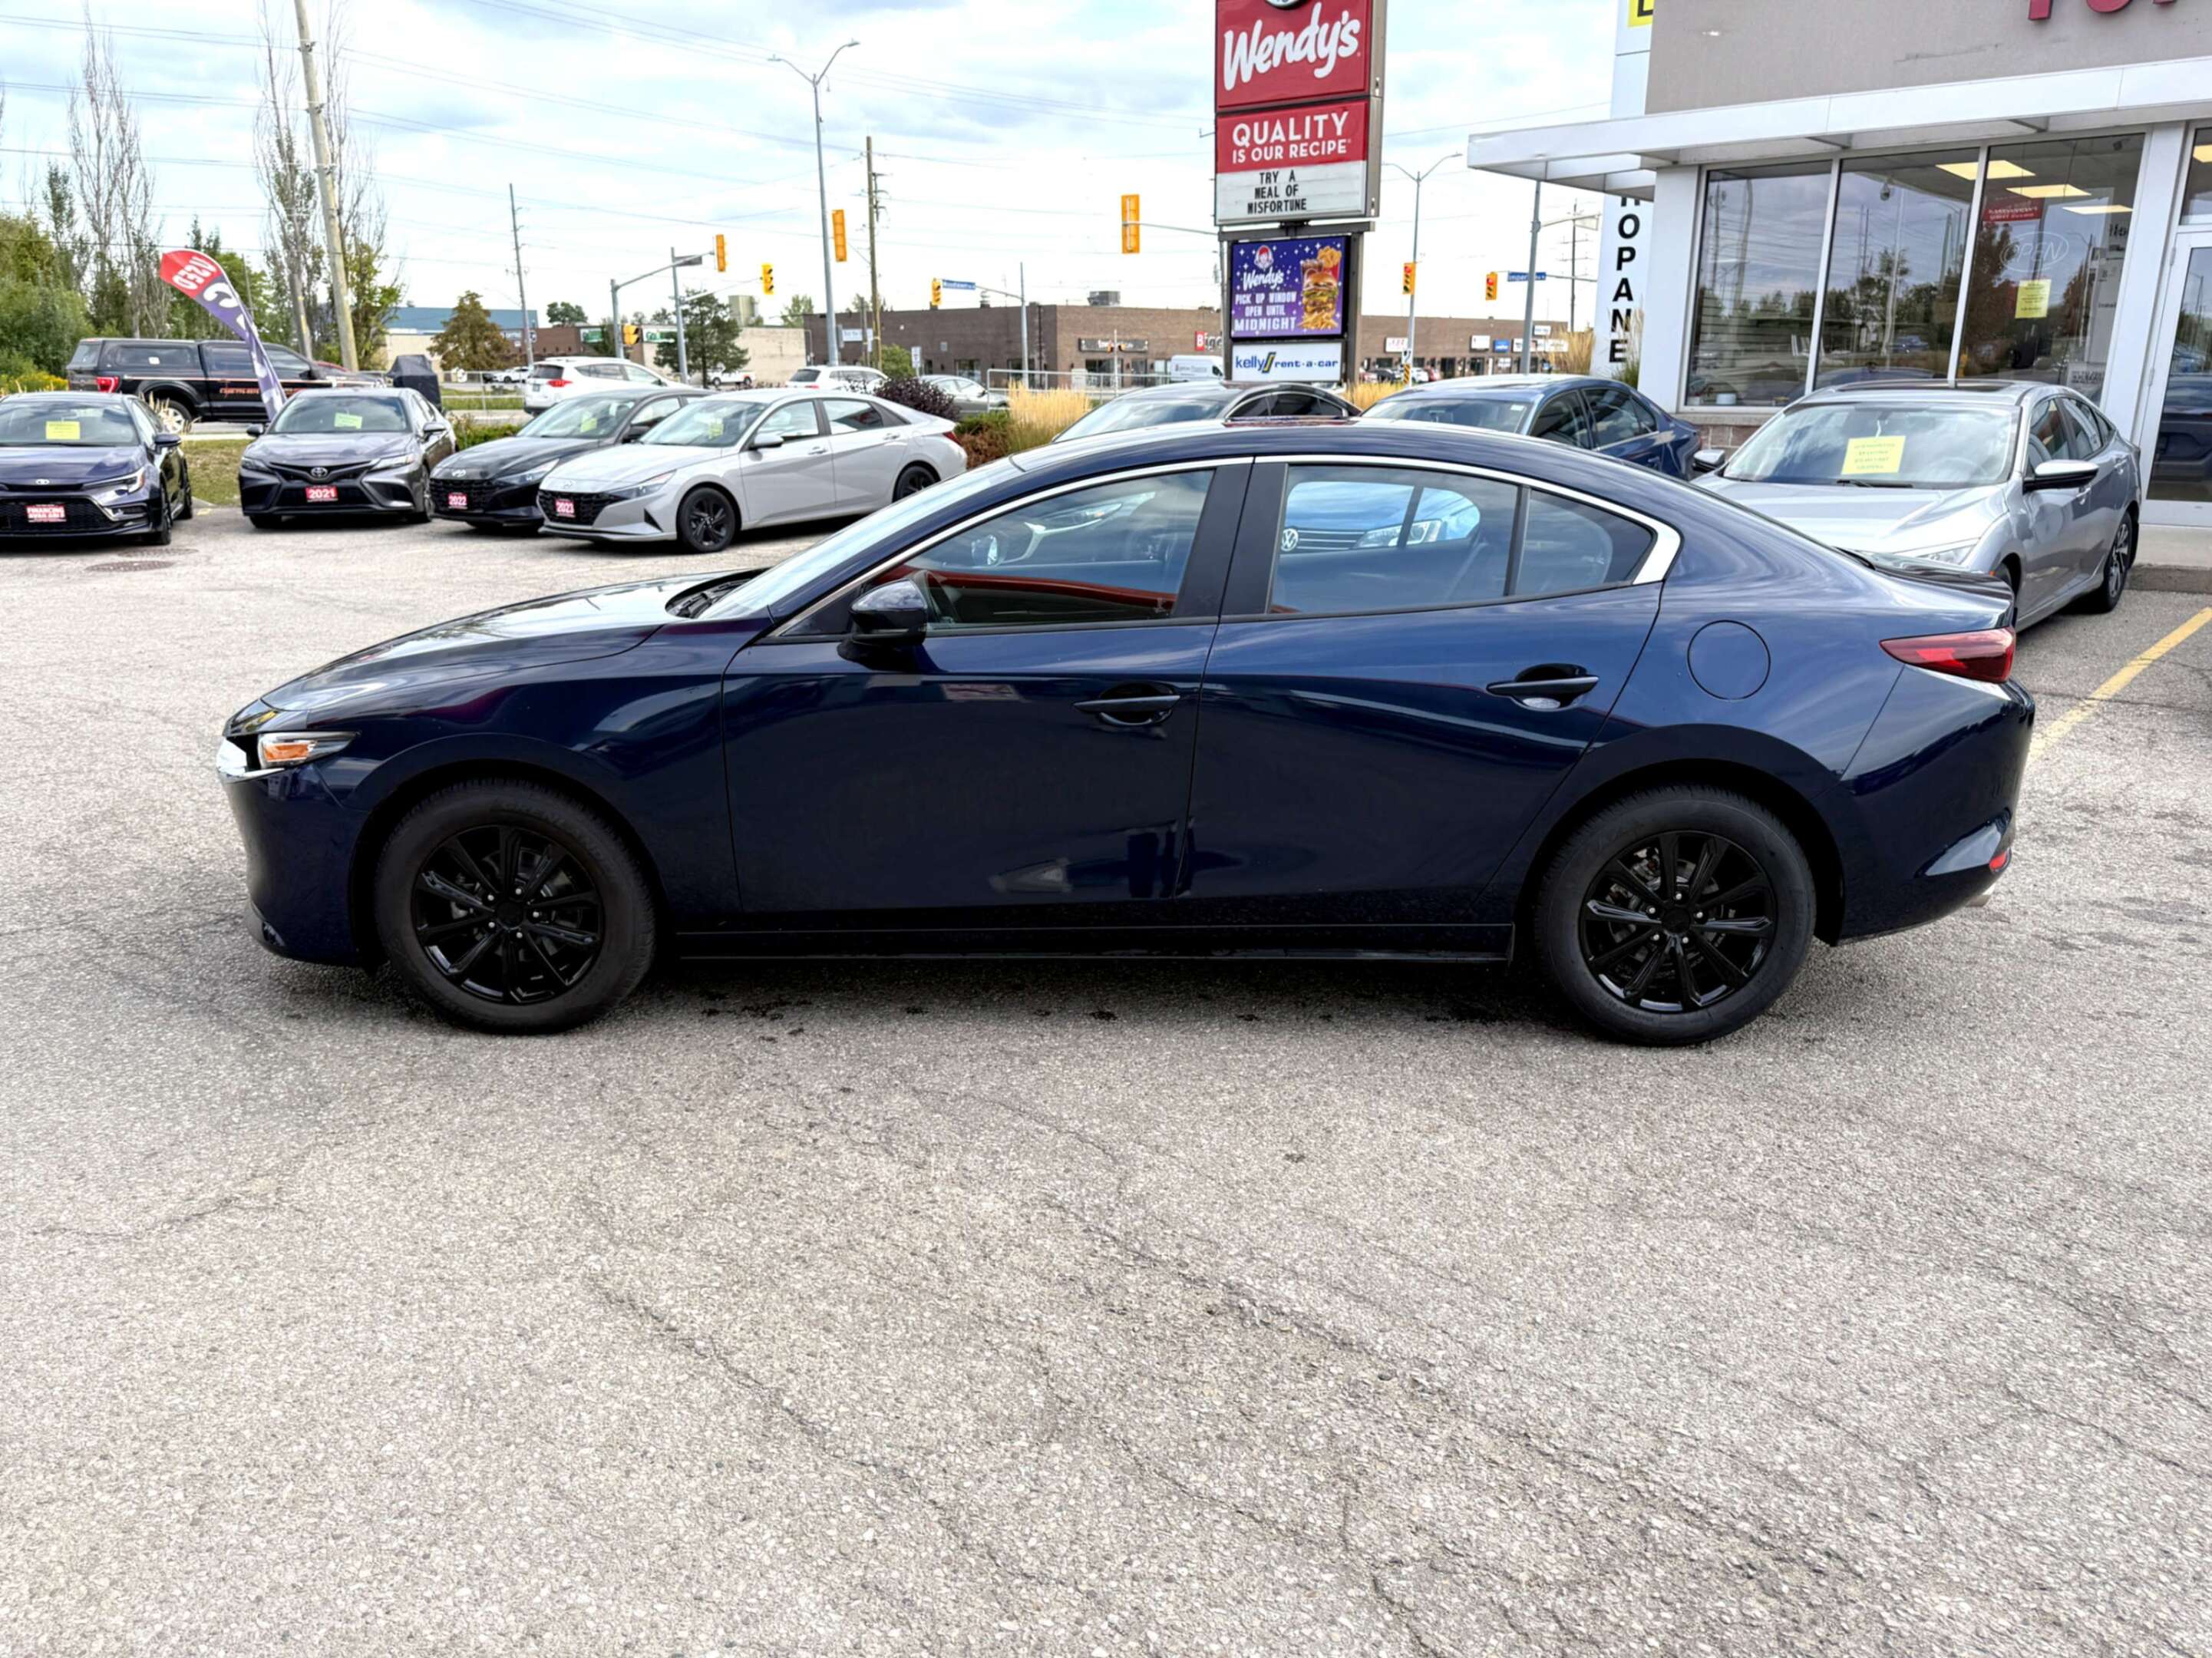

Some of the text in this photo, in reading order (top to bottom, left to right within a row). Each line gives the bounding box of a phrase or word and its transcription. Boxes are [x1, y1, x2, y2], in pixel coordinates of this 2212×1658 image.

[1223, 2, 1361, 91] Wendy's
[1232, 111, 1349, 147] QUALITY
[1232, 139, 1347, 163] IS OUR RECIPE
[1259, 170, 1296, 184] TRY A
[1254, 184, 1299, 199] MEAL OF
[1246, 198, 1307, 214] MISFORTUNE
[1243, 267, 1284, 291] Wendy's
[1235, 291, 1297, 305] PICK UP WINDOW
[1244, 305, 1286, 317] OPEN UNTIL
[1234, 317, 1297, 332] MIDNIGHT
[1235, 355, 1266, 371] kelly
[309, 487, 335, 499] 2021
[448, 494, 467, 505] 2022
